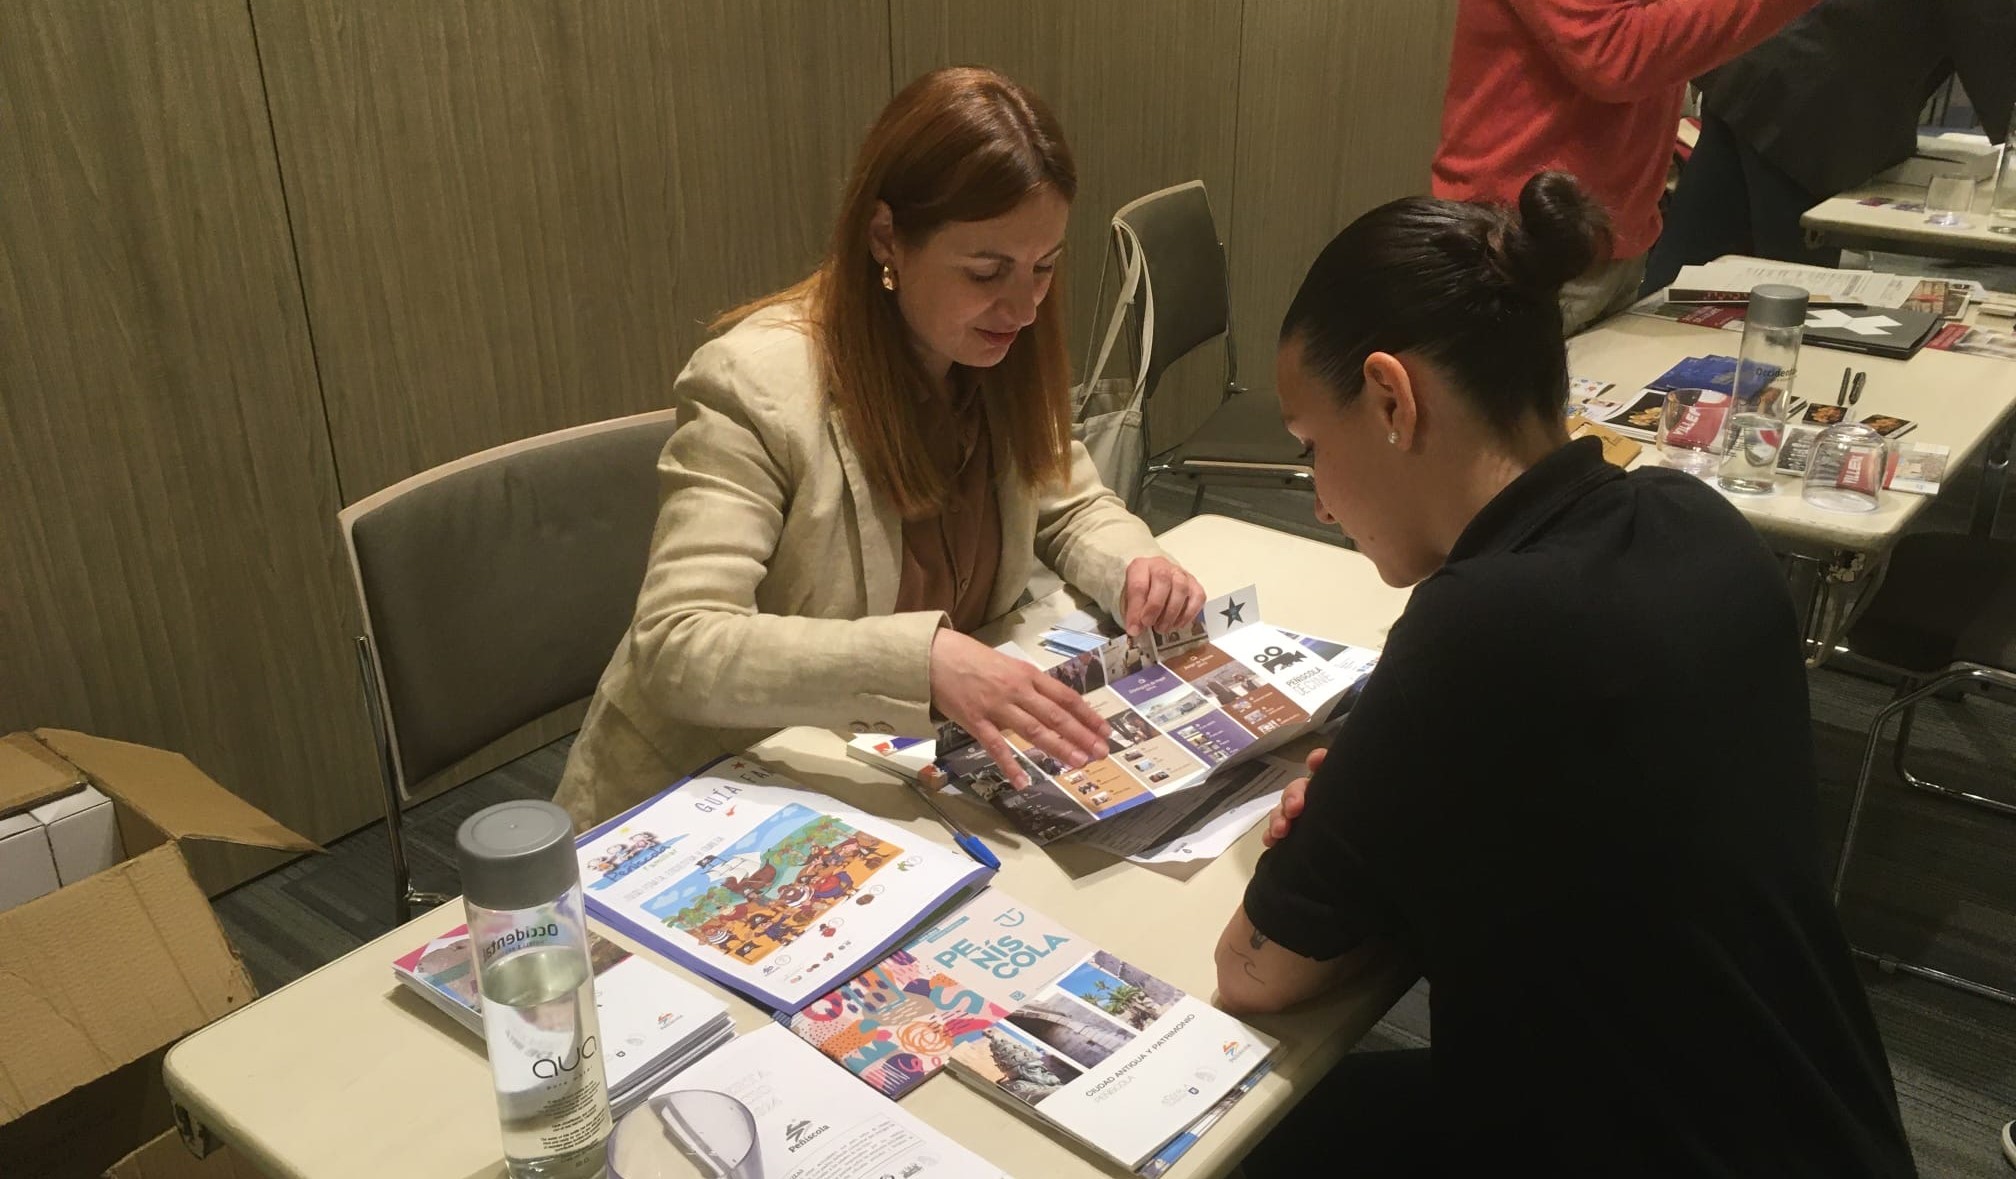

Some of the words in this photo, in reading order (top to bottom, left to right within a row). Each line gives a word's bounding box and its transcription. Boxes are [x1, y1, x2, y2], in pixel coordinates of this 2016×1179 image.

[694, 784, 743, 813] GUÍA
[933, 937, 974, 970] PE
[991, 933, 1072, 980] COLA
[1085, 1075, 1116, 1098] CIUDAD
[1114, 1052, 1147, 1078] ANTIGUA
[1145, 1047, 1154, 1056] Y
[1151, 1012, 1196, 1052] PATRIMONIO
